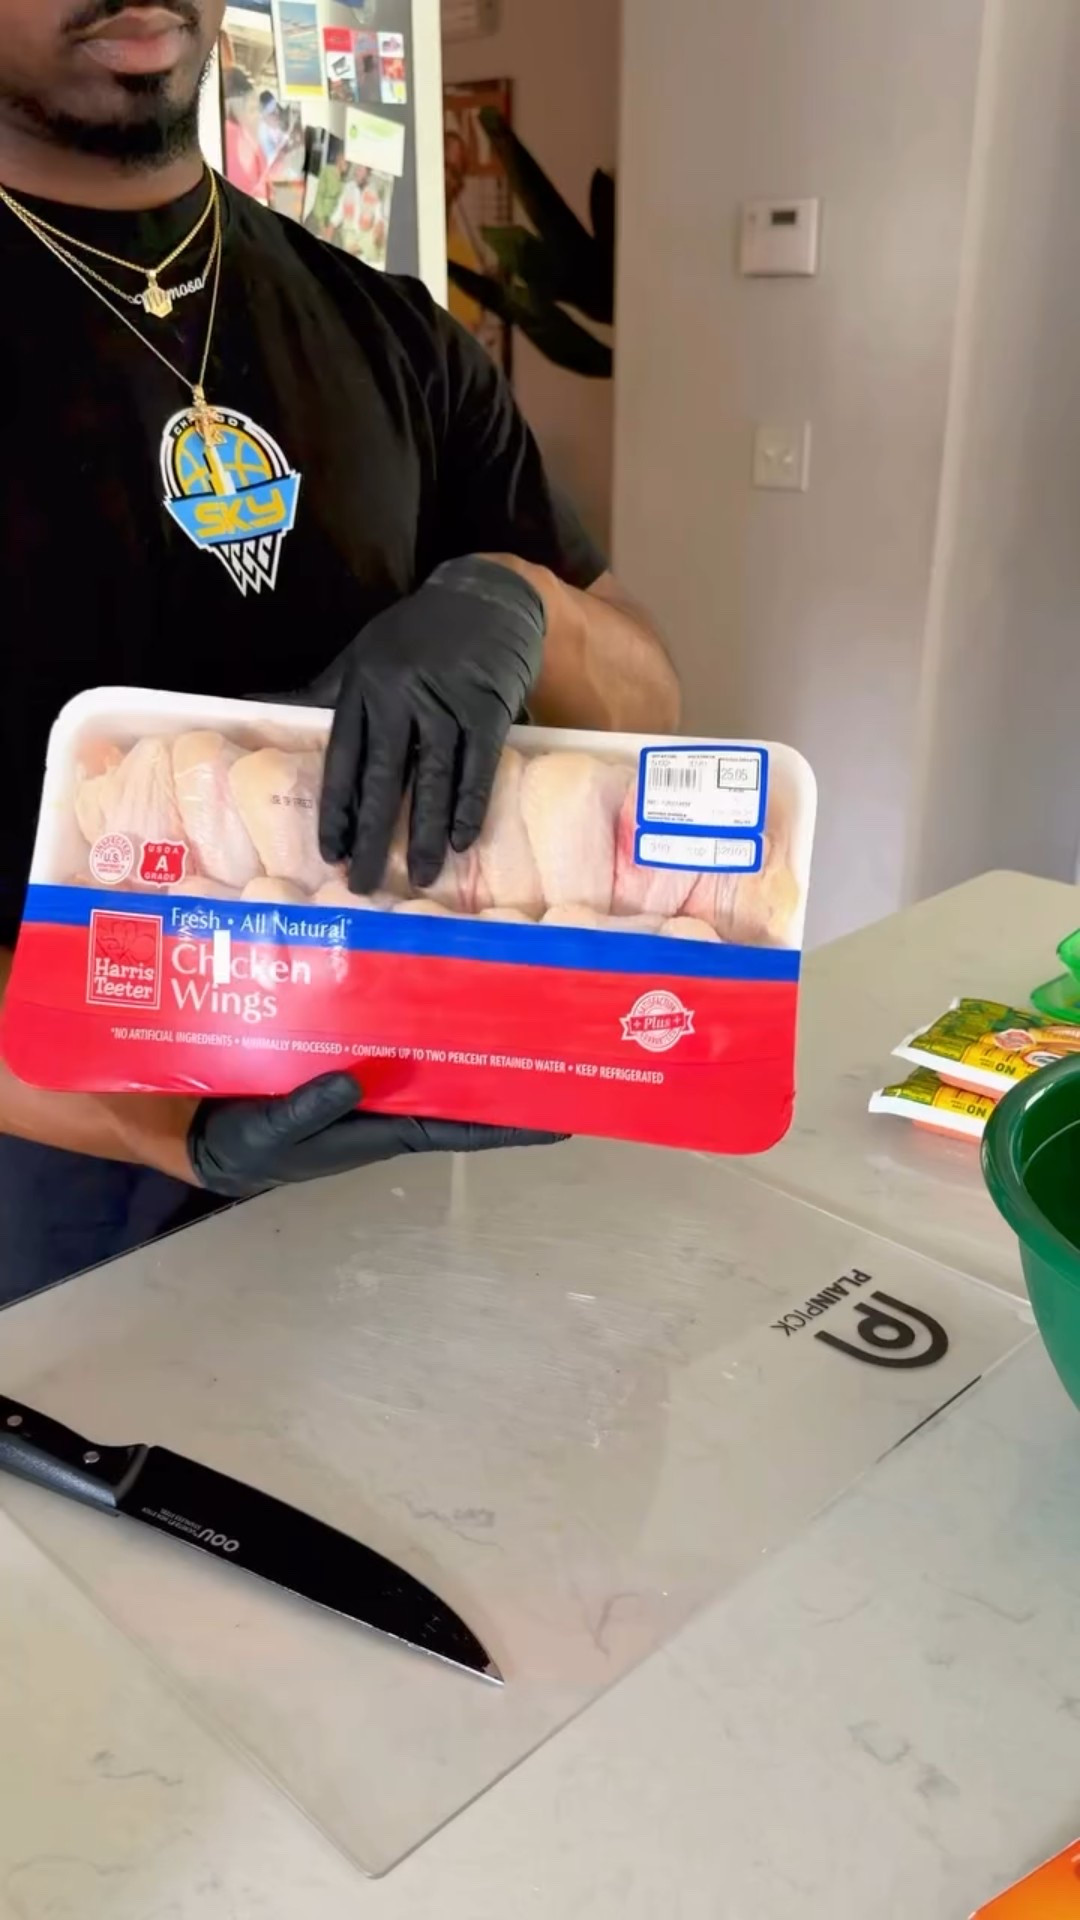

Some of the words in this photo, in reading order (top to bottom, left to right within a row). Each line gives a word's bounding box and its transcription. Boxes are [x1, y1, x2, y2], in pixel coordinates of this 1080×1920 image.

[173, 414, 238, 436] CHGO
[195, 488, 286, 538] SKY
[147, 845, 179, 855] USDA
[155, 855, 169, 872] A
[143, 872, 176, 881] GRADE
[171, 906, 220, 930] Fresh
[240, 913, 266, 934] All
[95, 957, 155, 980] Harris
[171, 943, 311, 985] Chcken
[94, 977, 153, 999] Teeter
[171, 978, 278, 1024] Wings
[643, 1015, 672, 1030] Plus
[129, 1028, 174, 1043] ARTIFICIAL
[175, 1031, 234, 1048] INGREDIENTS
[291, 1040, 342, 1055] PROCESSED
[351, 1044, 397, 1058] CONTAINS
[398, 1047, 411, 1059] UP
[412, 1049, 424, 1060] TO
[426, 1049, 447, 1063] TWO
[448, 1051, 488, 1066] PERCENT
[490, 1054, 534, 1070] RETAINED
[535, 1058, 566, 1073] WATER
[575, 1063, 598, 1077] KEEP
[599, 1065, 664, 1084] REFRIGERATED
[770, 1268, 873, 1337] PLAINPICK
